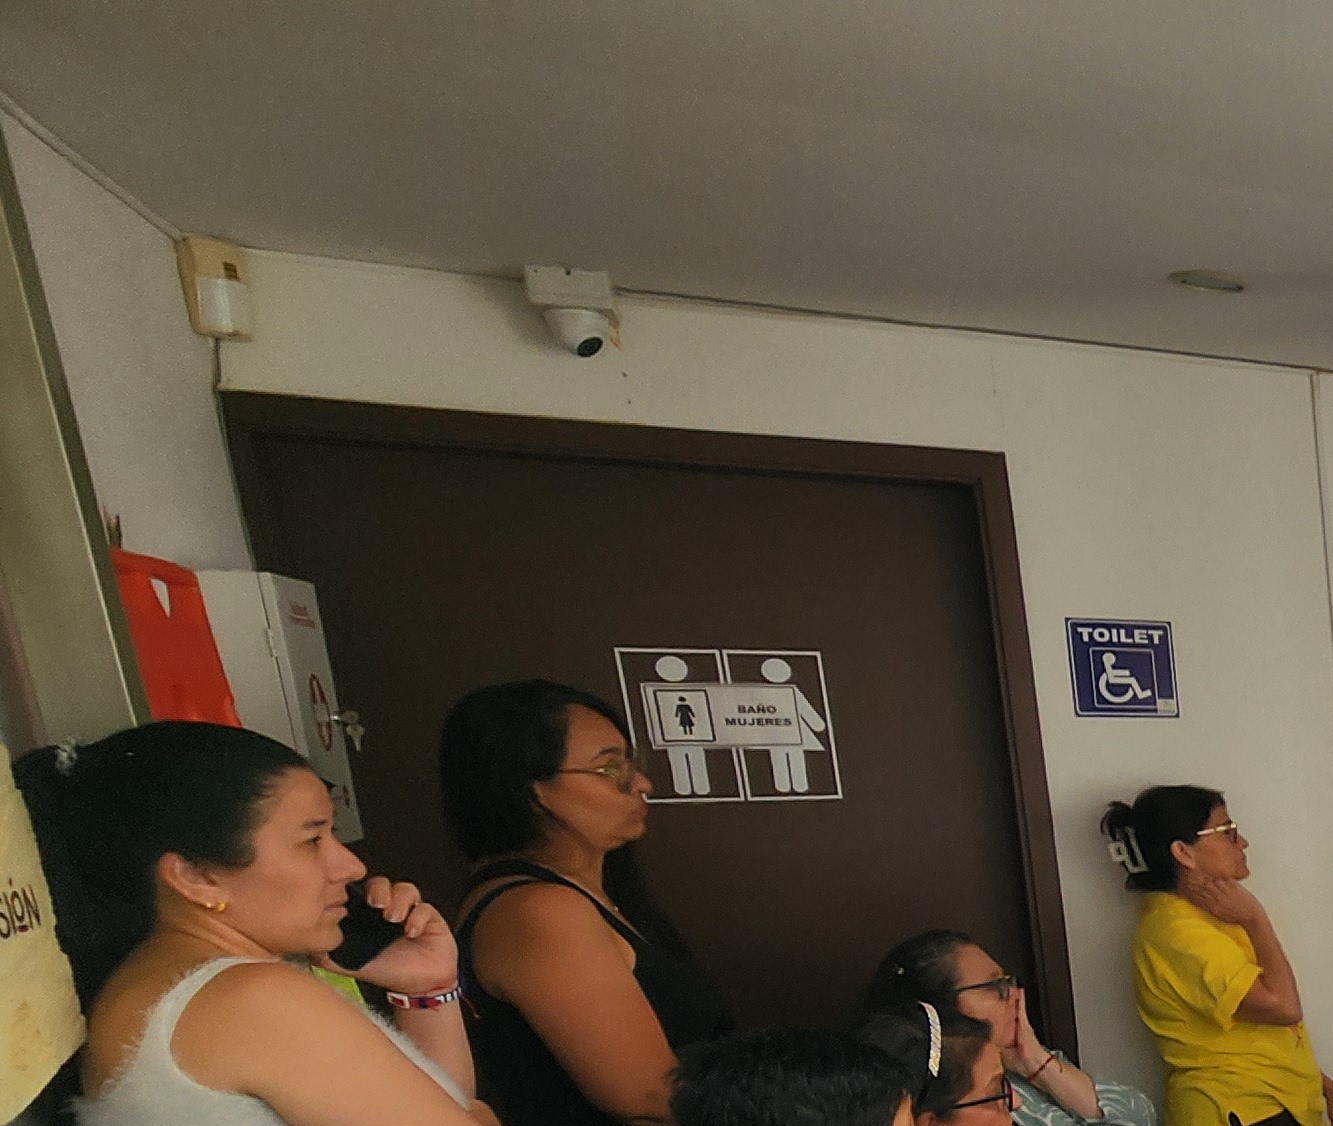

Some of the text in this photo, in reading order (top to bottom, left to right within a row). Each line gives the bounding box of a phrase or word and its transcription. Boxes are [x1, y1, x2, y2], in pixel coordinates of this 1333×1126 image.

[1076, 626, 1164, 645] TOILET
[737, 703, 777, 714] BAÑO
[724, 716, 792, 727] MUJERES
